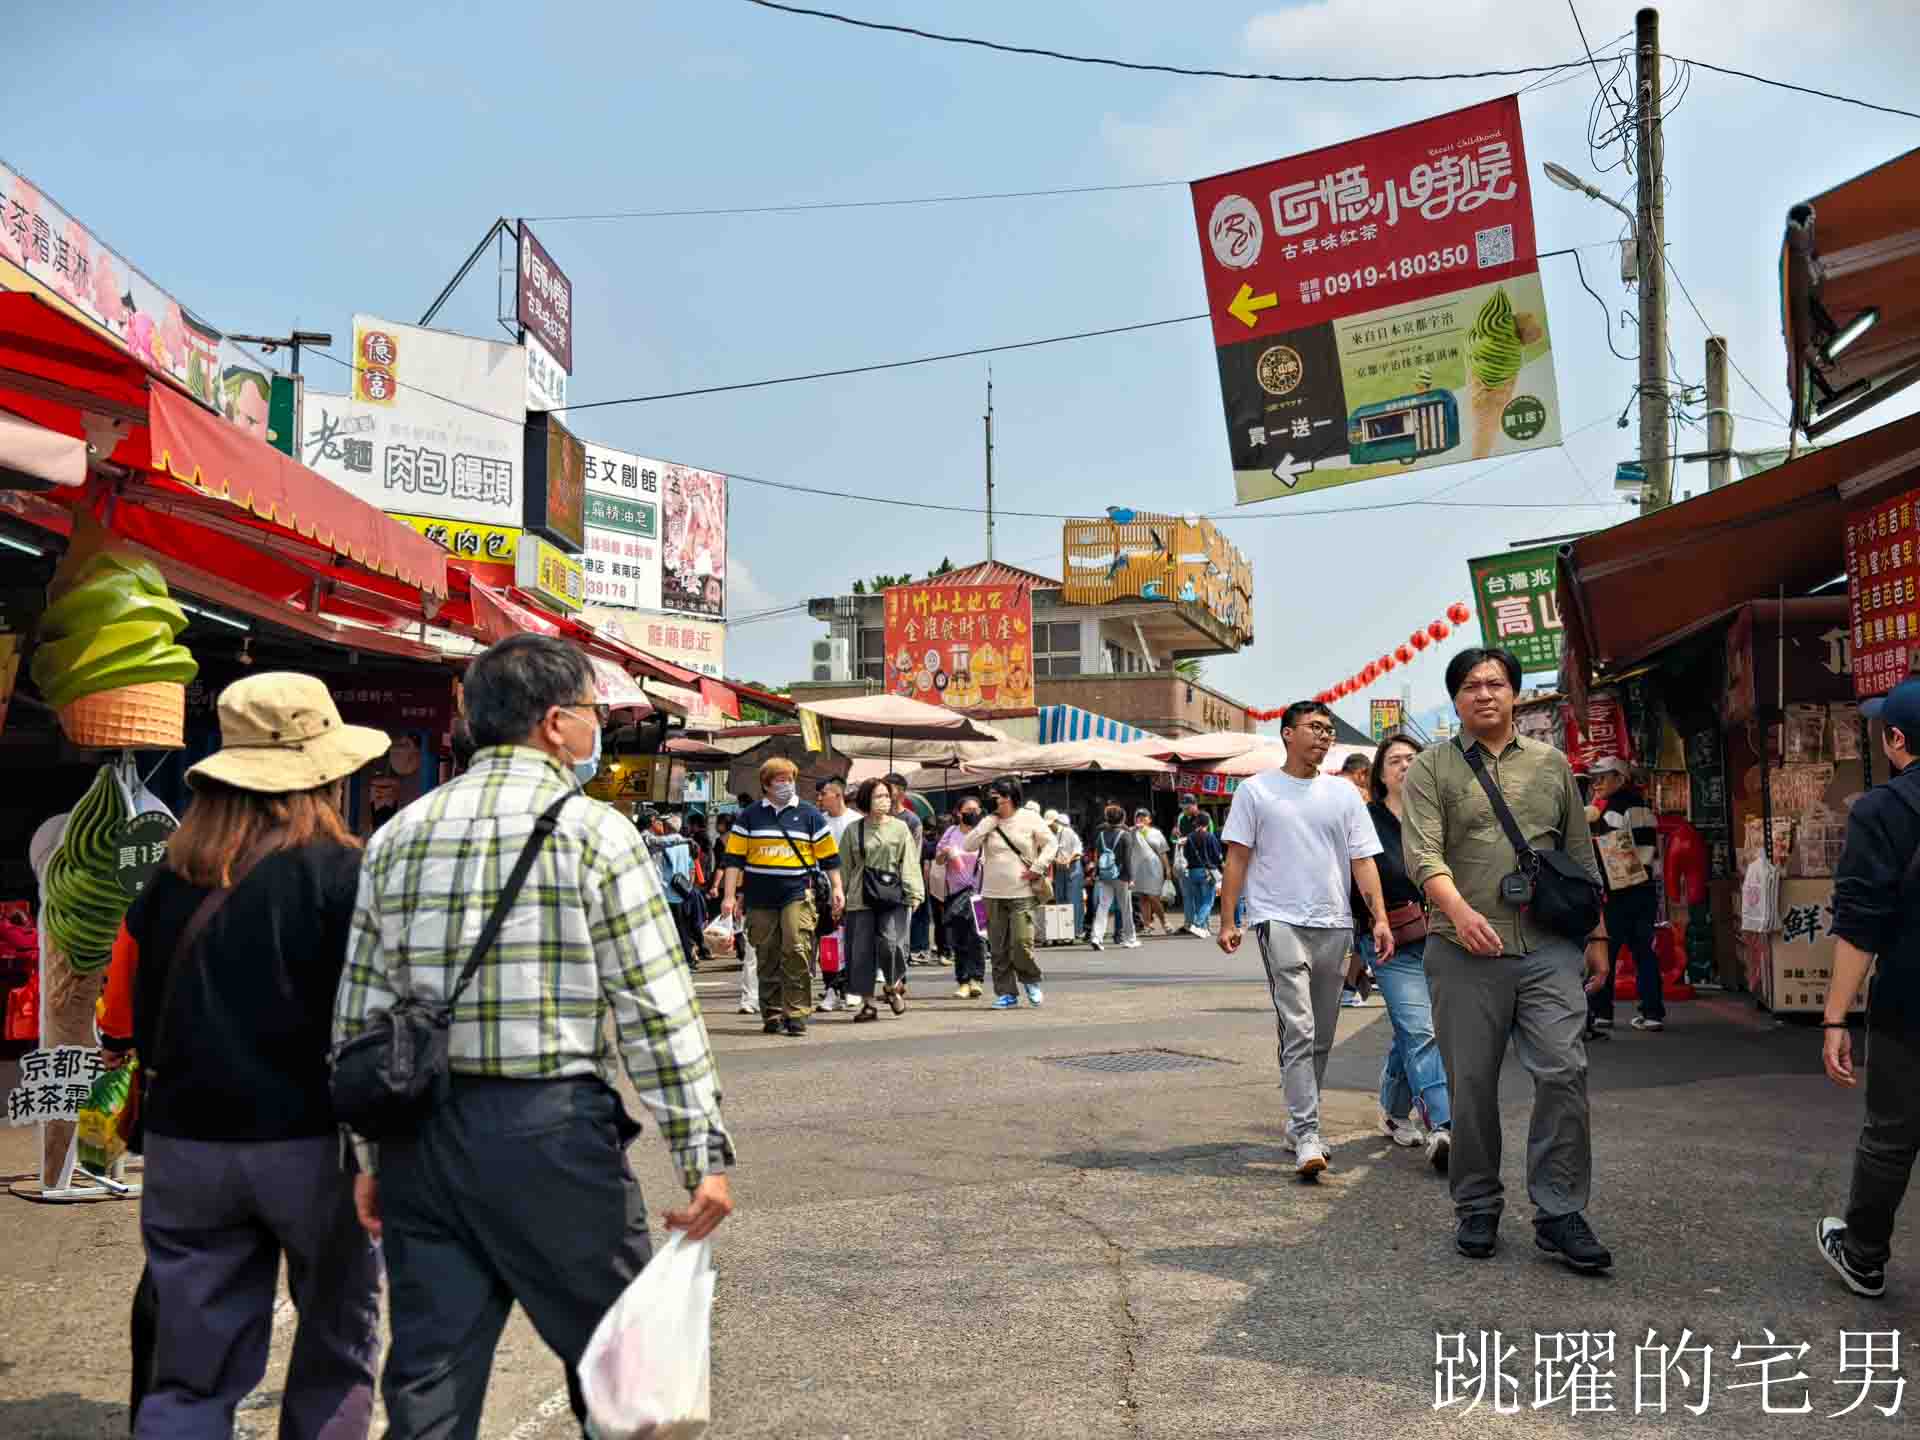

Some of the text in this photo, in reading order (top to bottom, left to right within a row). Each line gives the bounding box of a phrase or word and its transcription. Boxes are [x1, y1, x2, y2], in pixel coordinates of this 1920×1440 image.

[1270, 141, 1518, 237] 回憶小時候
[0, 192, 89, 289] 茶霜淇淋
[1281, 223, 1378, 261] 古早味紅茶
[1324, 244, 1469, 296] 0919-180350
[1247, 414, 1334, 448] 買一送一
[384, 446, 448, 495] 肉包
[452, 453, 512, 506] 饅頭
[1487, 568, 1557, 593] 台灣兆
